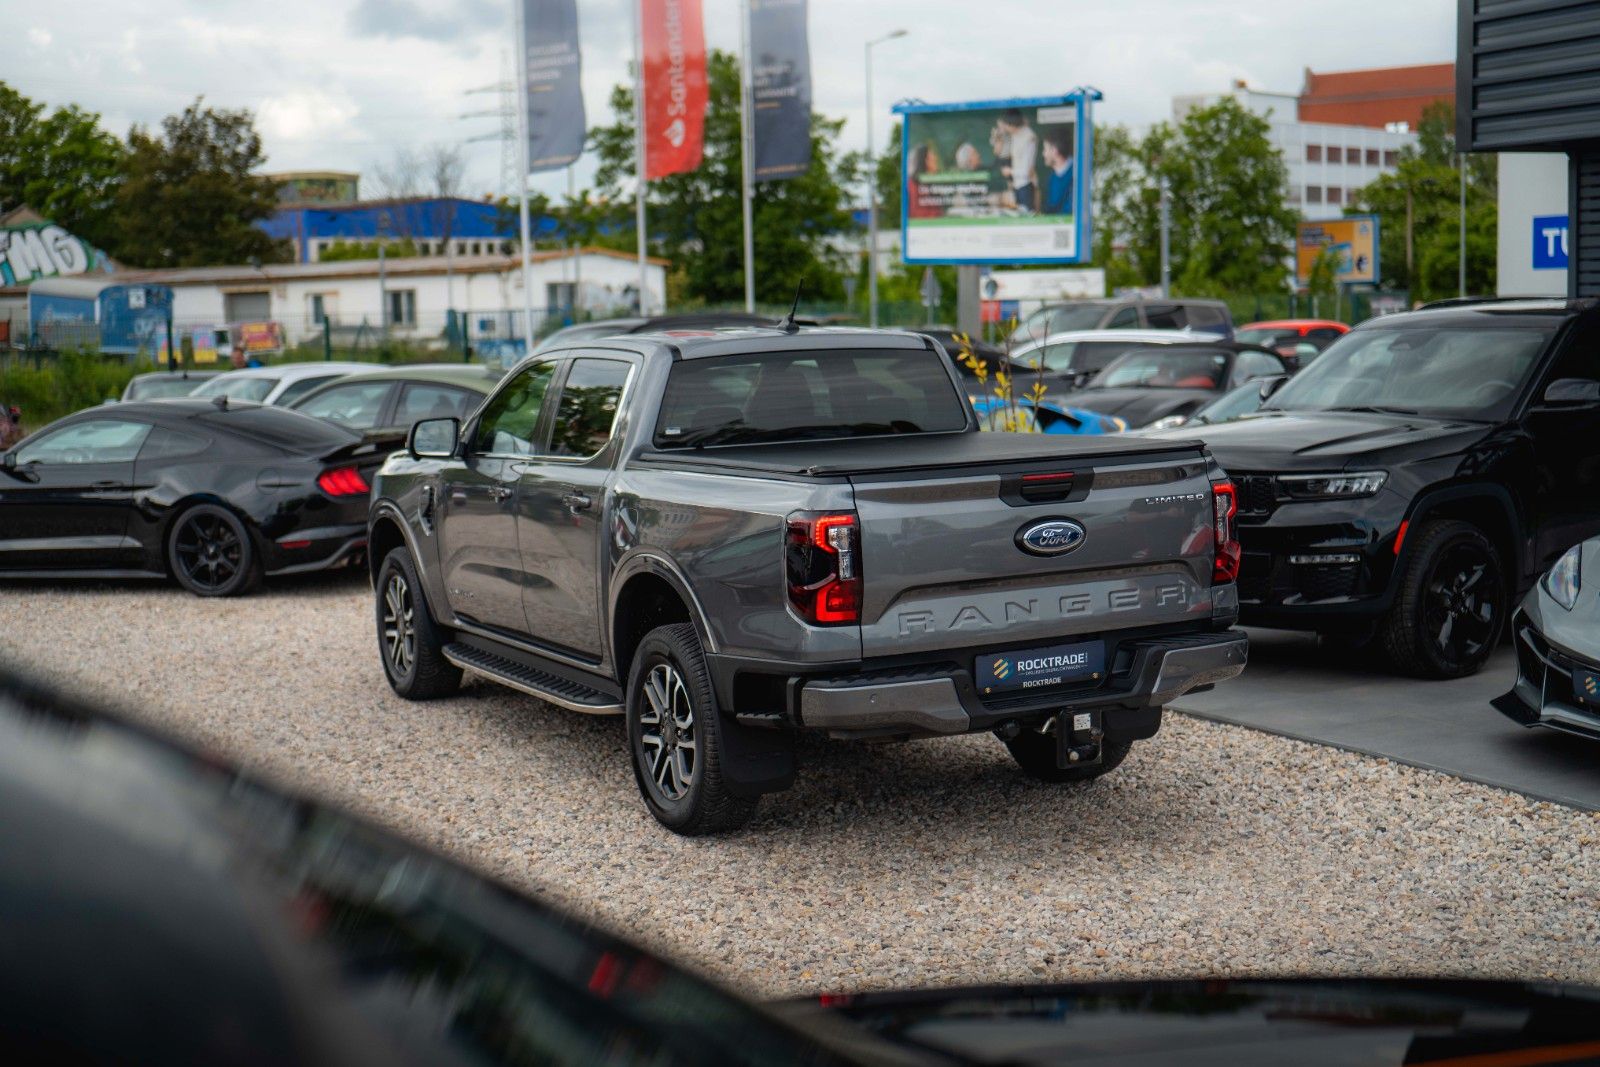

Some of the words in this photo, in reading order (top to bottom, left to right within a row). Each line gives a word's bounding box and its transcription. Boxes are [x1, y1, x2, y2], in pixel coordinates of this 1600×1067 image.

[665, 0, 687, 116] Santander
[1146, 494, 1204, 504] LIMITED
[1039, 529, 1071, 546] Ford
[898, 581, 1185, 635] RANGER
[1017, 653, 1085, 671] ROCKTRADE
[1022, 677, 1061, 688] ROCKTRADE
